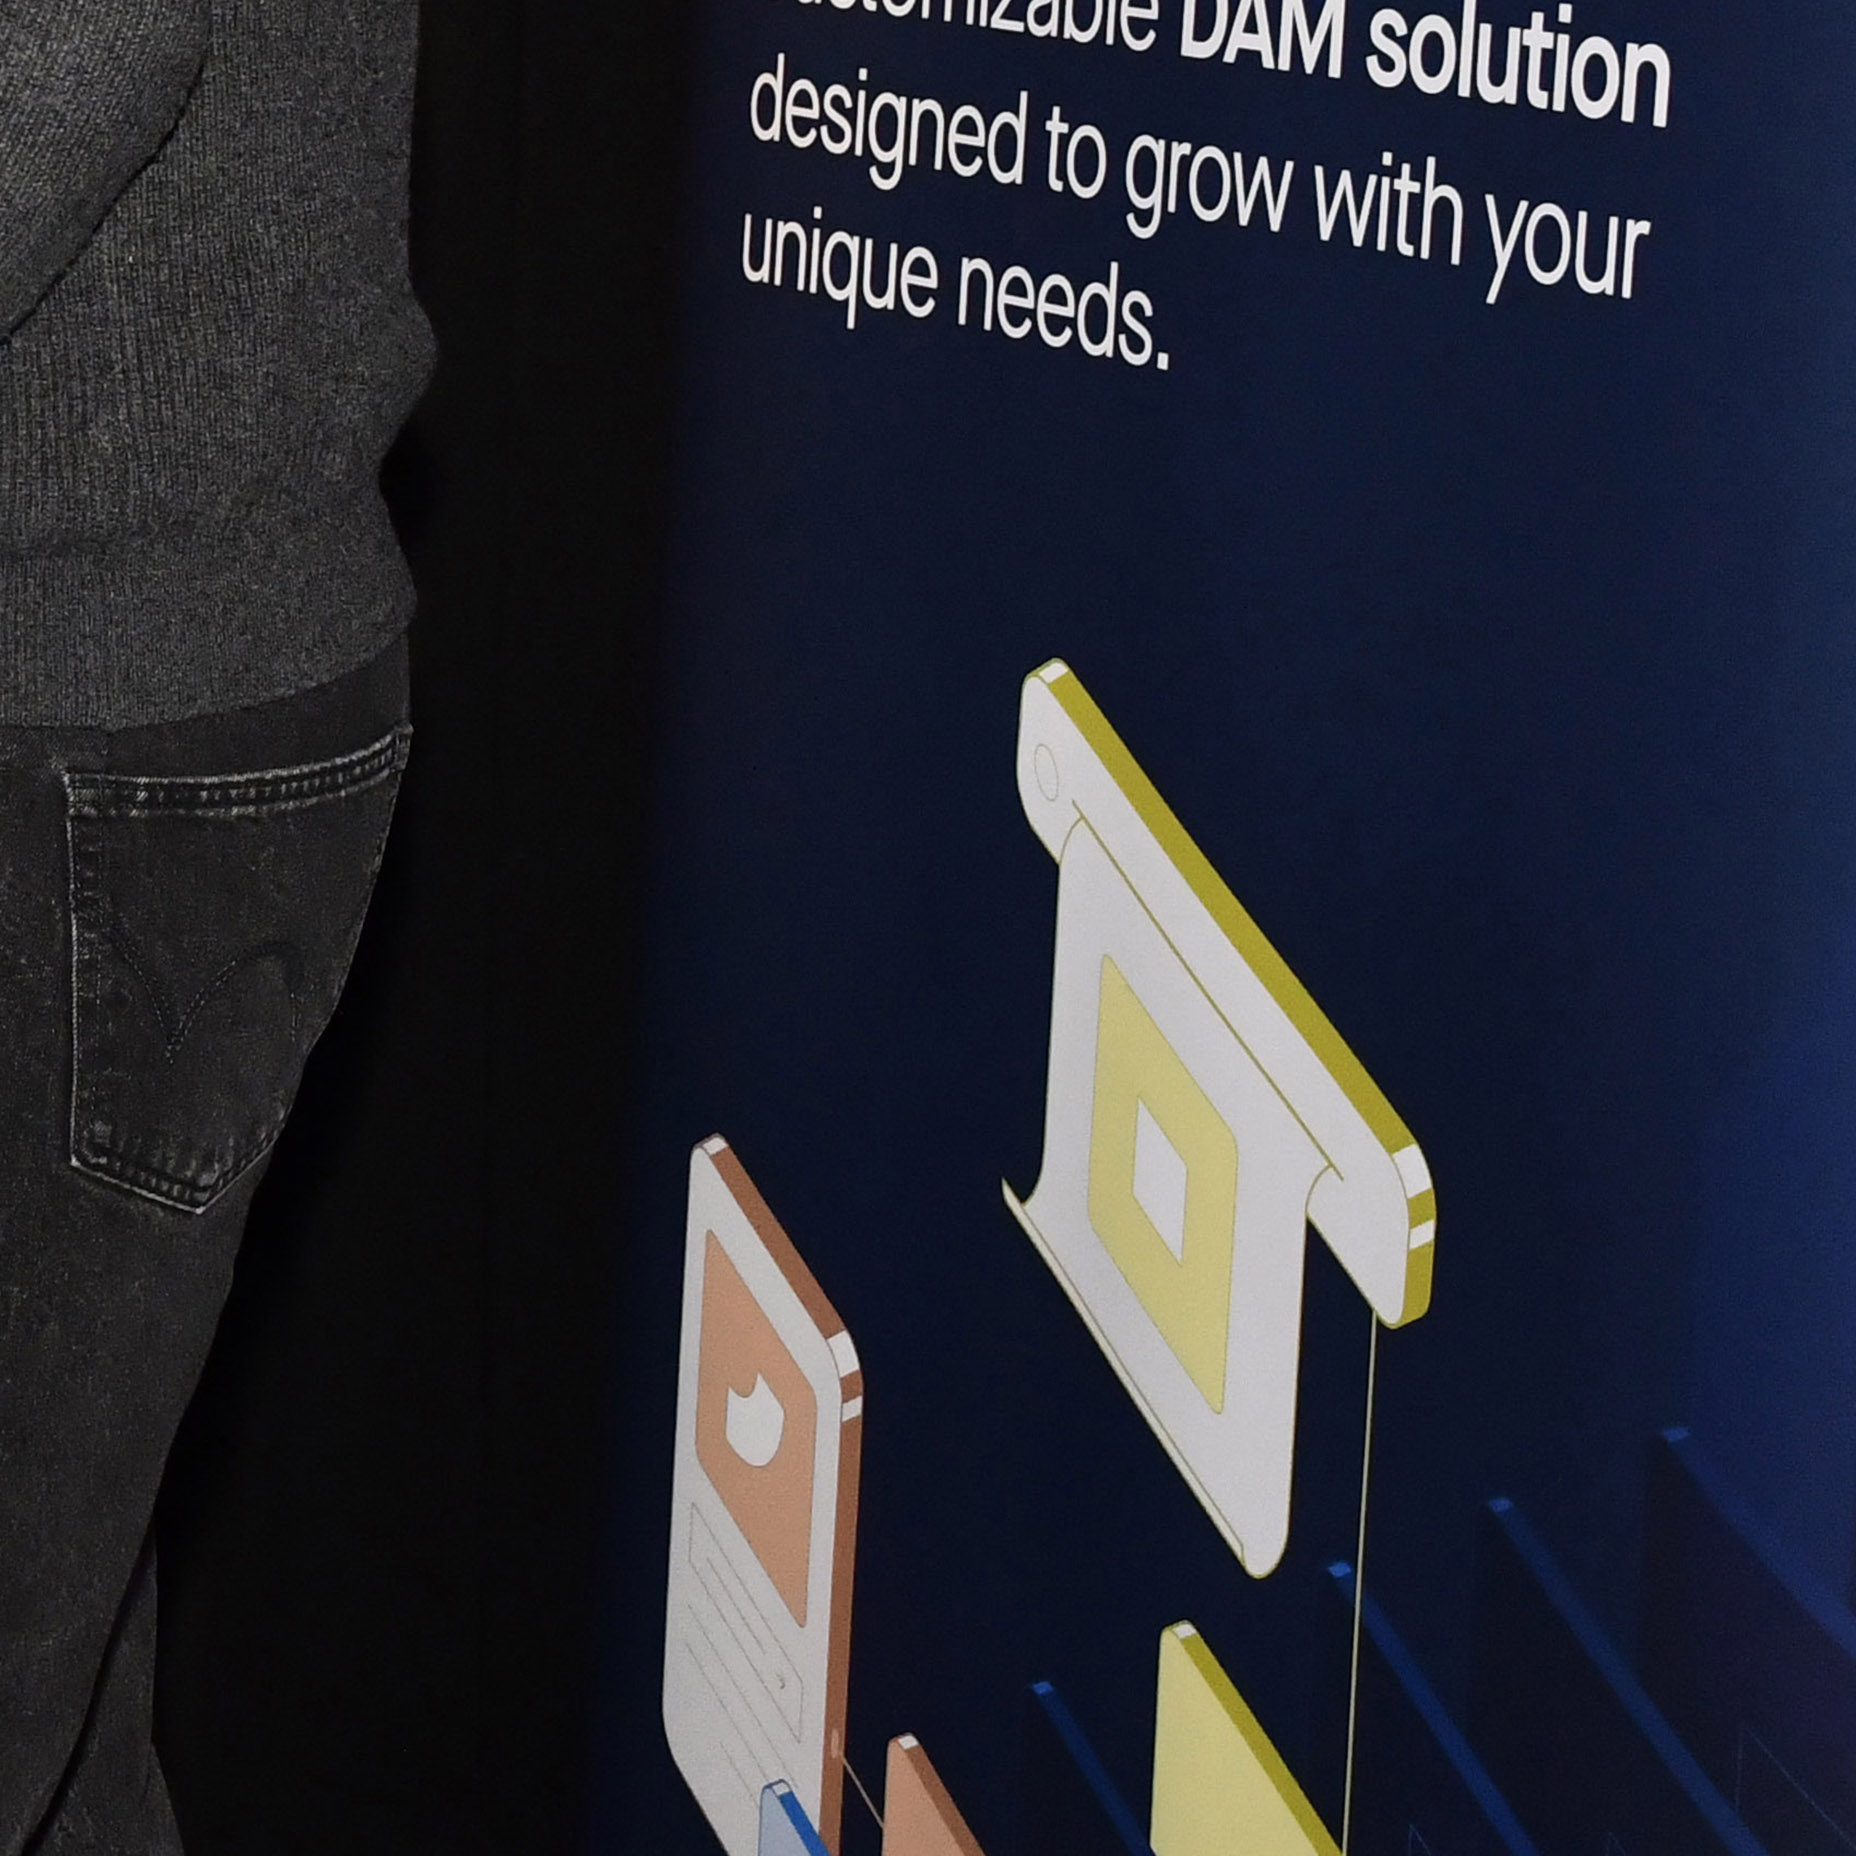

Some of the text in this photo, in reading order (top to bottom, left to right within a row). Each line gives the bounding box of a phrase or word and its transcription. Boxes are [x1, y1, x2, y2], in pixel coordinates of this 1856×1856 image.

[751, 53, 1651, 304] designed to grow with your
[743, 206, 1168, 370] unique needs.
